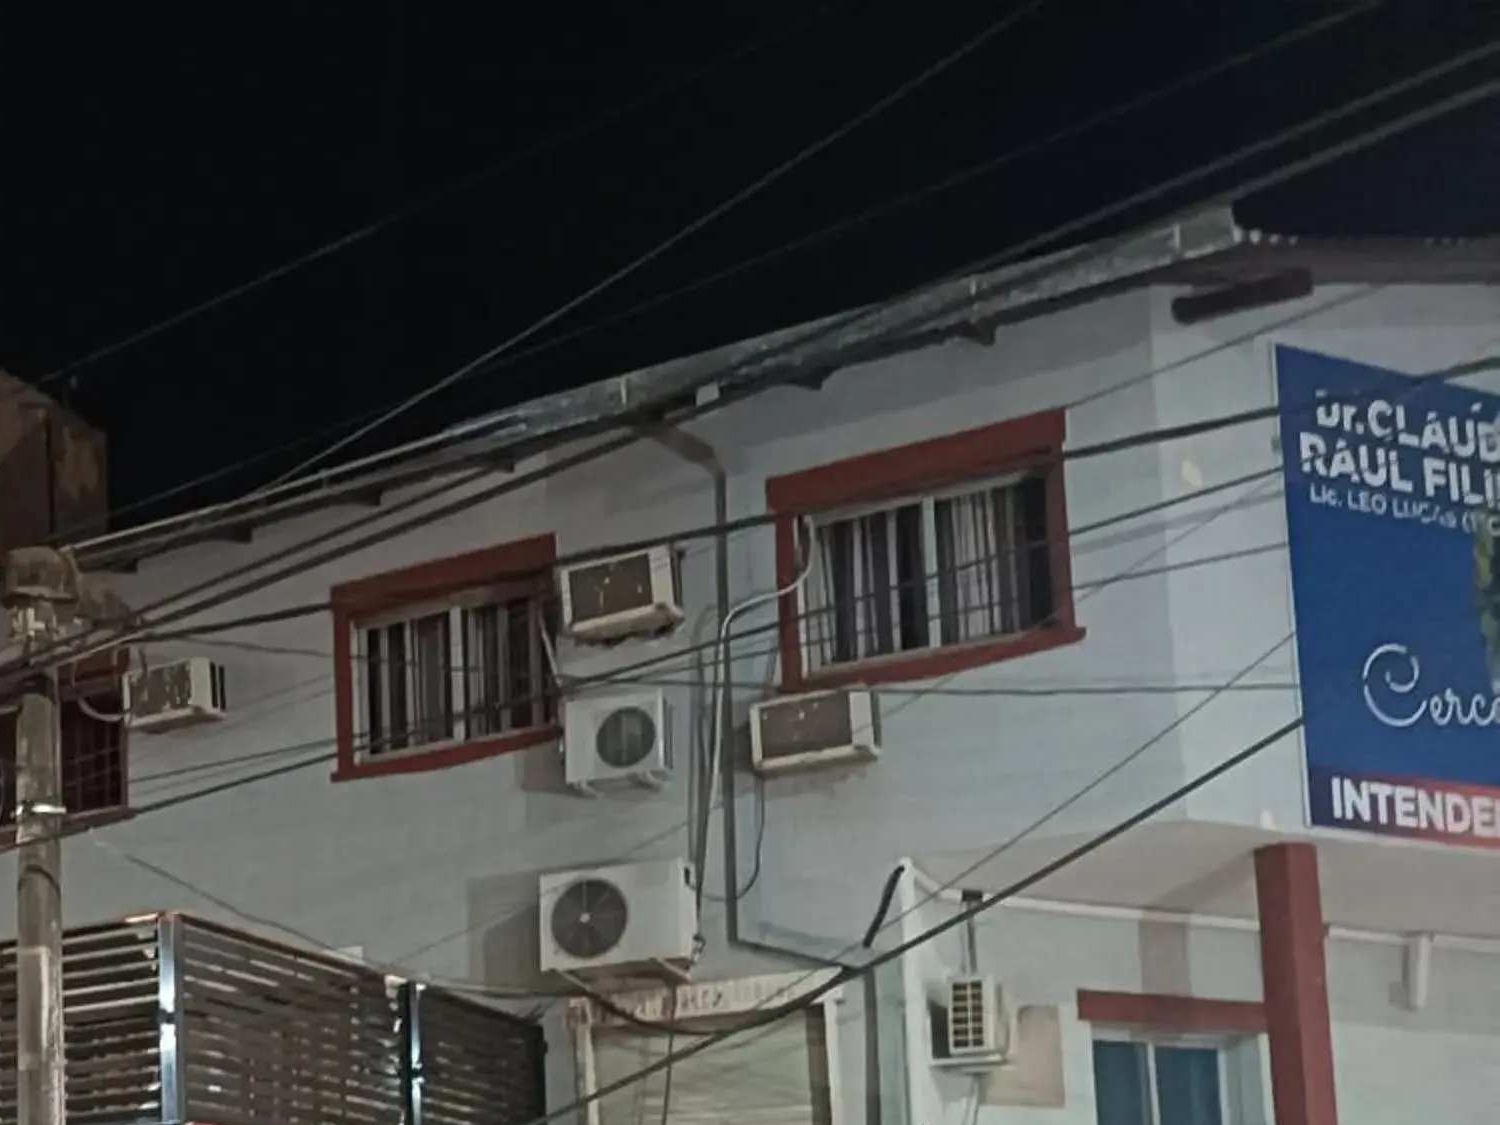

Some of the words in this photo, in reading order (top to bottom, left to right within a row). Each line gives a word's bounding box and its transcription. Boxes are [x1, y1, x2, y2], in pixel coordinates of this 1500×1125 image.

[1299, 431, 1414, 493] RAUL
[1348, 490, 1388, 517] LEO
[1331, 777, 1500, 838] INTENDE
